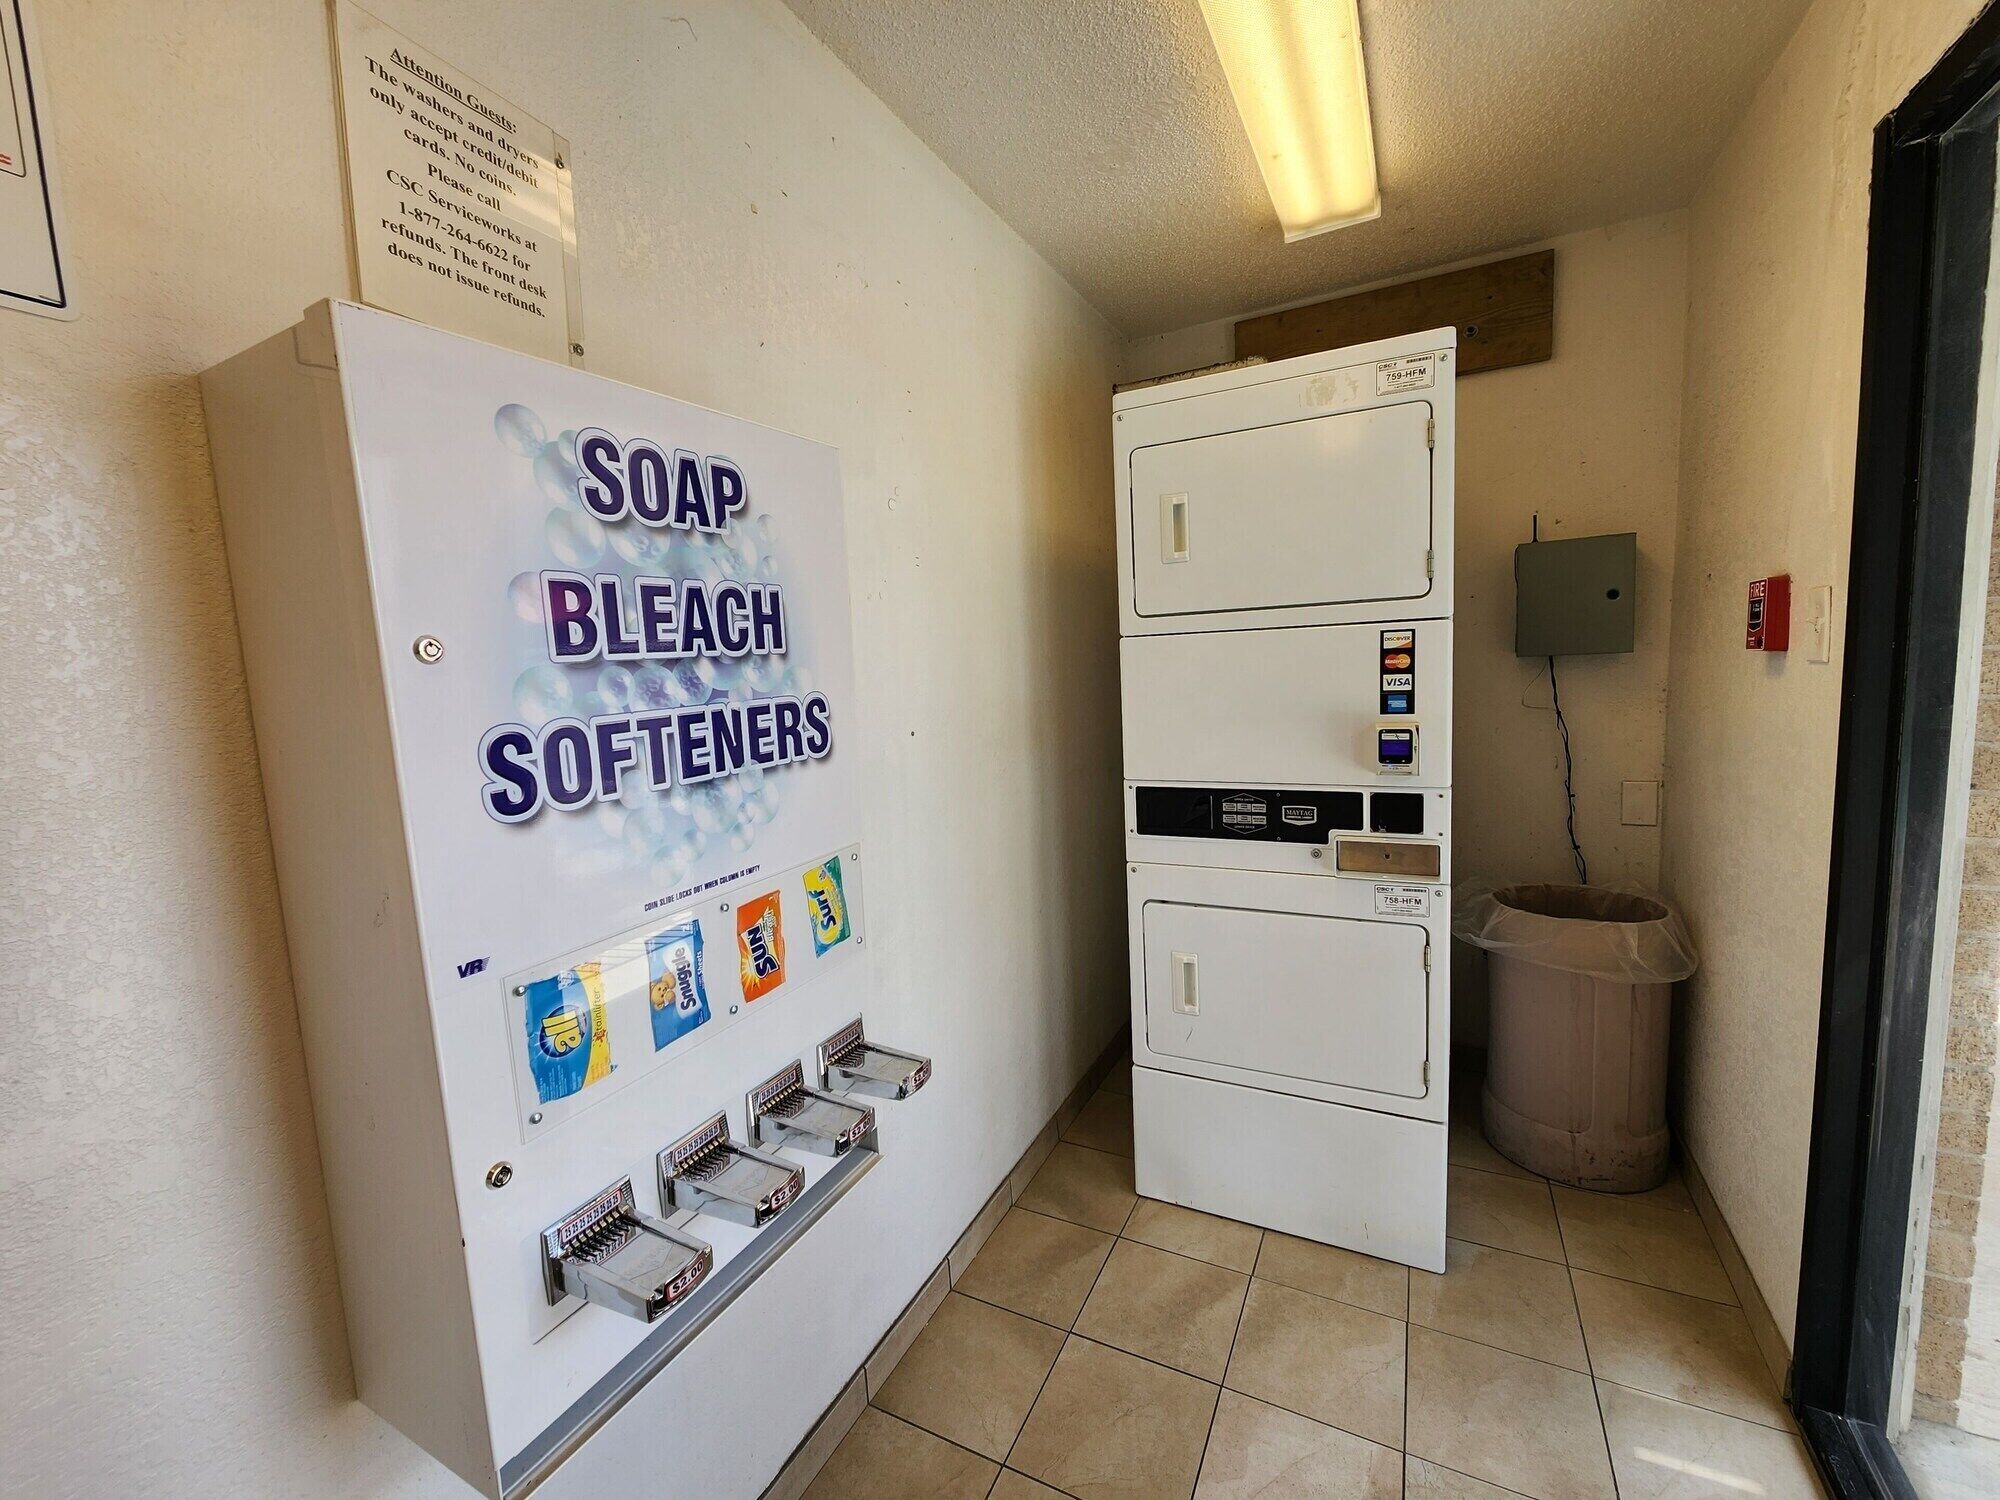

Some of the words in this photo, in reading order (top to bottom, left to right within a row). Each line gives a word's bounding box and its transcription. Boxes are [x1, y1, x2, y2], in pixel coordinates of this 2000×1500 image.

[365, 56, 398, 86] The
[403, 80, 463, 125] washers
[468, 118, 494, 143] and
[498, 135, 539, 169] dryers
[390, 48, 462, 100] Attention
[467, 94, 517, 133] Guests:
[370, 86, 405, 115] only
[411, 107, 459, 143] accept
[463, 139, 539, 189] credit/debit
[404, 127, 450, 161] cards.
[454, 152, 475, 175] No
[479, 169, 517, 196] coins.
[386, 169, 424, 197] CSC
[428, 189, 521, 245] Serviceworks
[525, 239, 537, 253] at
[427, 163, 473, 197] Please
[477, 189, 501, 212] call
[381, 217, 446, 255] refunds.
[450, 245, 478, 268] The
[482, 262, 515, 286] front
[519, 278, 548, 300] desk
[399, 201, 509, 262] 1-877-264-6622
[513, 253, 531, 272] for
[388, 243, 424, 267] does
[428, 260, 452, 279] not
[456, 270, 490, 295] issue
[494, 288, 546, 318] refunds.
[1386, 367, 1427, 381] 759-HFM
[578, 432, 746, 531] SOAP
[544, 575, 786, 661] BLEACH
[1750, 581, 1766, 598] FIRE
[1386, 678, 1411, 686] VISA
[482, 694, 832, 820] SOFTENERS
[644, 901, 658, 912] COIN
[659, 895, 675, 907] SLIDE
[676, 888, 692, 900] LOCKS
[693, 884, 703, 894] OUT
[704, 879, 719, 890] WHEN
[720, 872, 739, 885] COLUMN
[740, 869, 745, 878] IS
[745, 864, 760, 876] EMPTY
[808, 889, 836, 931] Surf
[1384, 896, 1422, 905] 758-HFM
[457, 958, 488, 979] VR
[672, 947, 697, 1011] Snuggle
[747, 922, 780, 978] SUN
[541, 1010, 582, 1054] all
[774, 1178, 799, 1205] $2.00
[672, 1261, 704, 1294] $2.00
